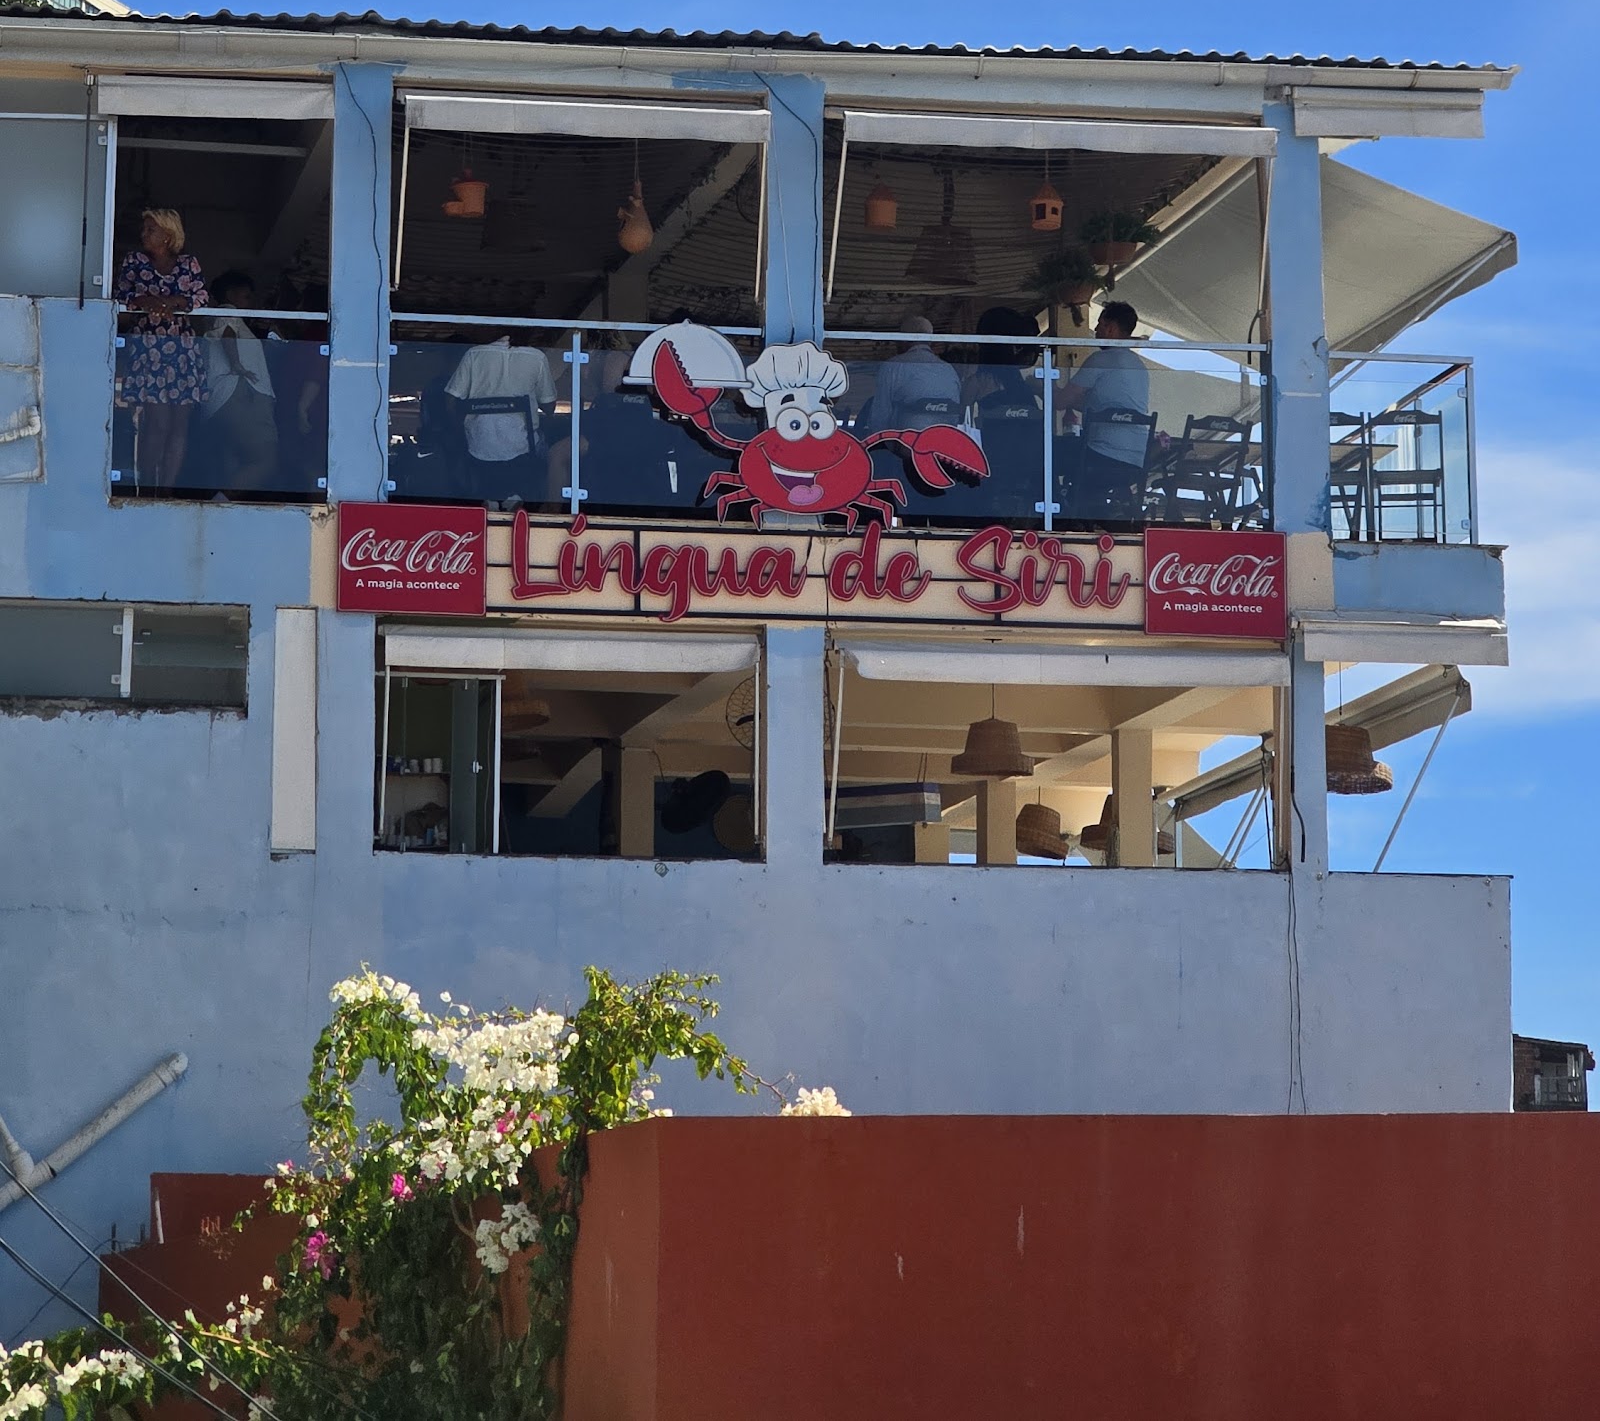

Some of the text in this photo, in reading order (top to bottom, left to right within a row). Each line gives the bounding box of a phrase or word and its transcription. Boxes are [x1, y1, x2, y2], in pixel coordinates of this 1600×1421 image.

[341, 527, 482, 575] Coca-Cola
[511, 508, 1131, 623] Língua de Siri
[355, 578, 460, 590] A magia acontece
[1148, 552, 1282, 598] Coca-Cola
[1162, 601, 1263, 613] A magia acontece
